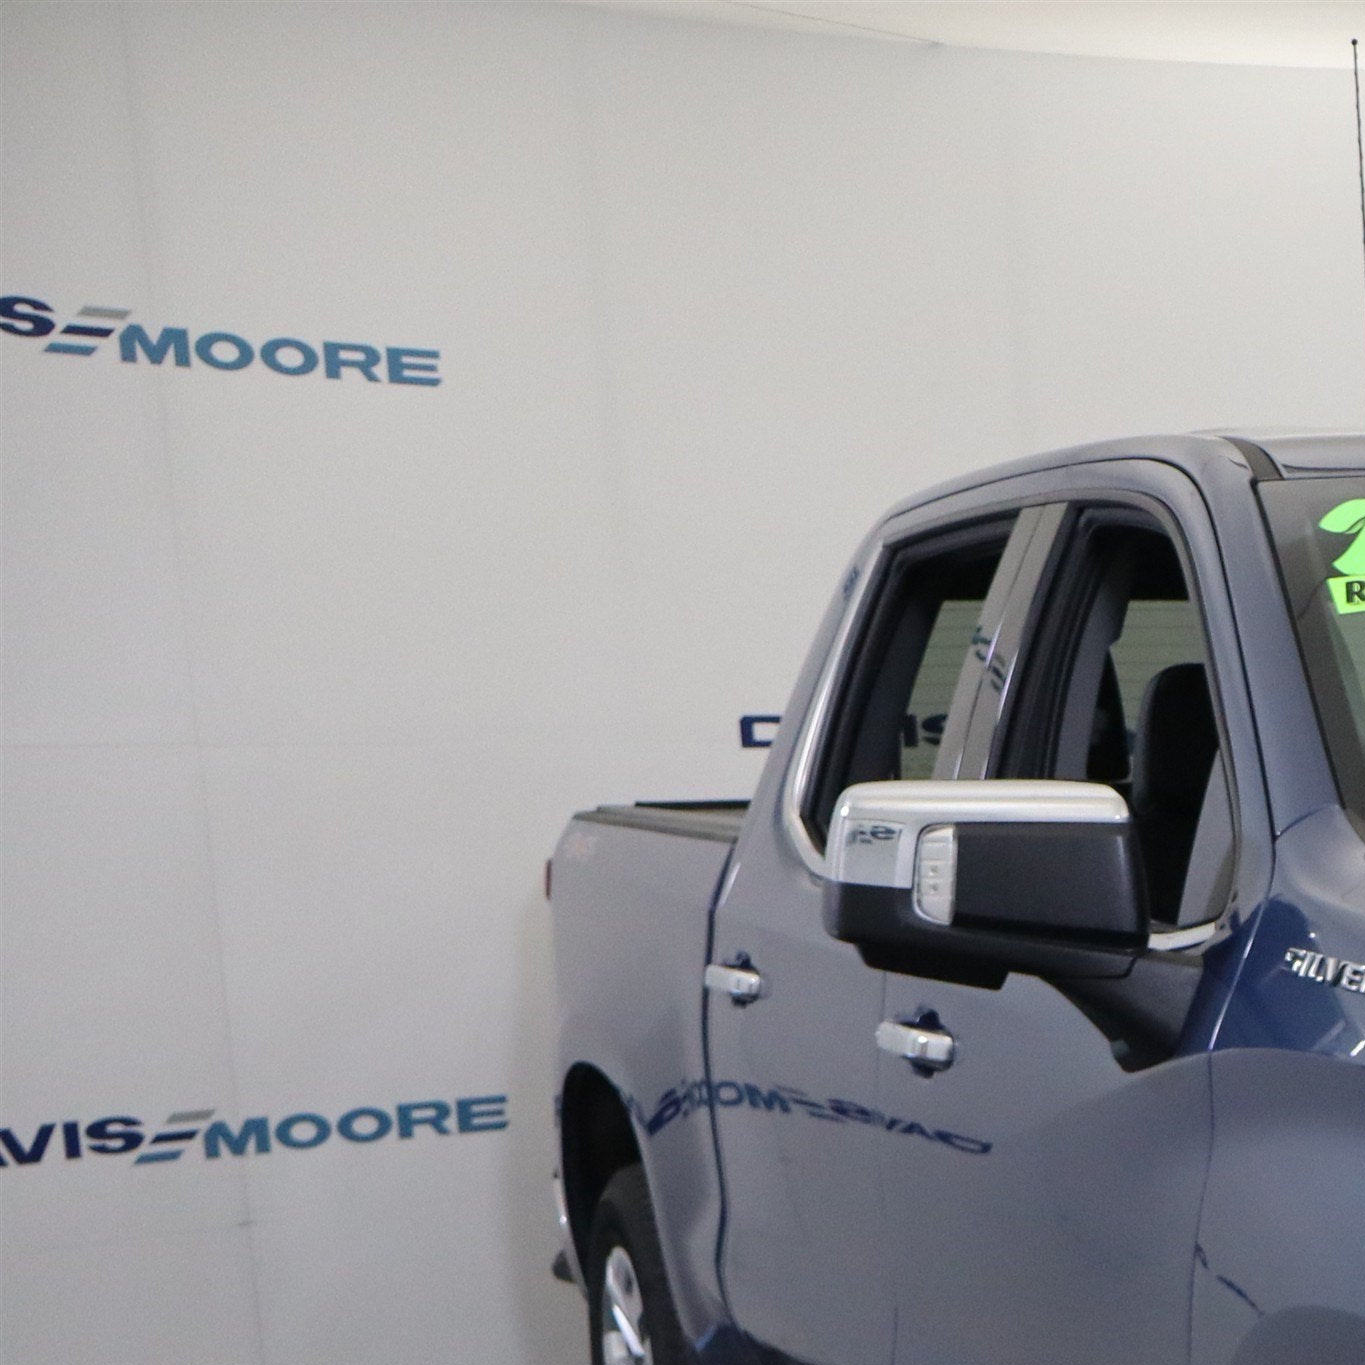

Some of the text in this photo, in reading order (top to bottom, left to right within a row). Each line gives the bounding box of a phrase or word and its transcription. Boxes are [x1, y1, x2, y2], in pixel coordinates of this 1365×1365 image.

[118, 324, 442, 387] MOORE
[0, 1094, 511, 1168] VIS MOORE
